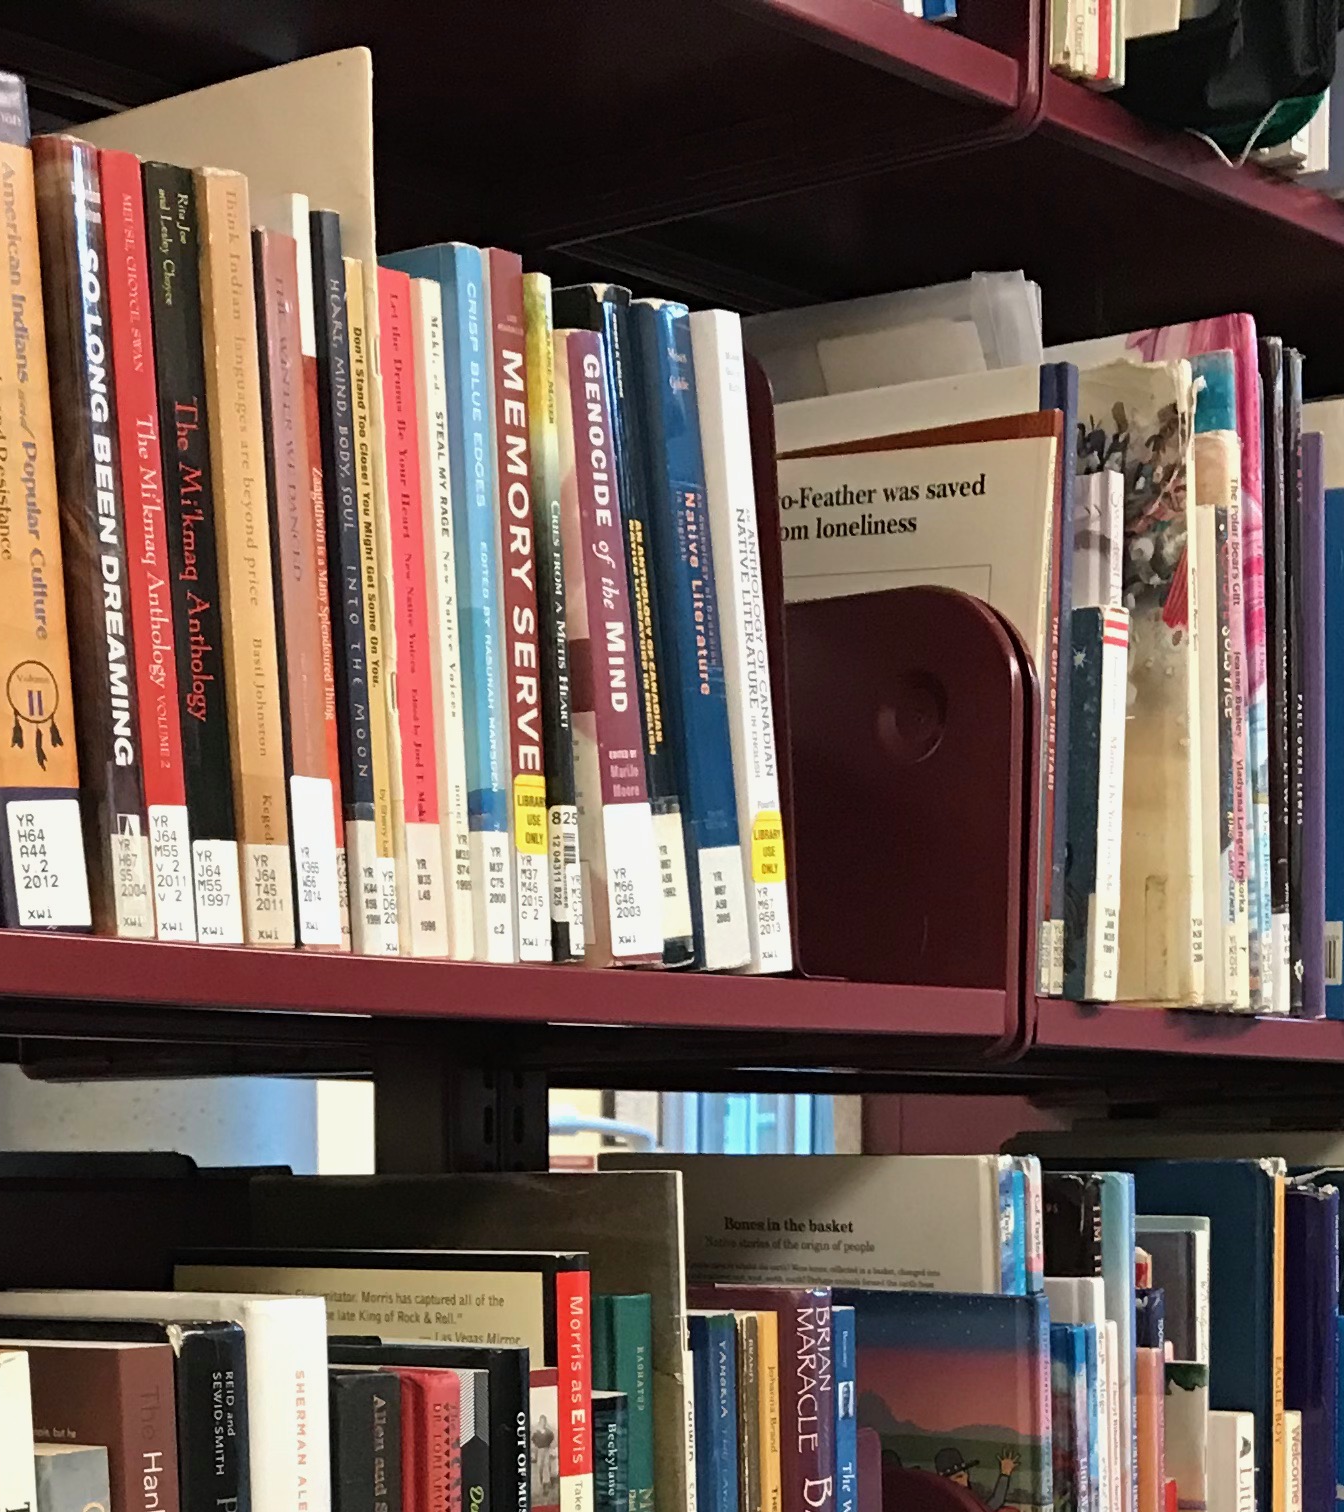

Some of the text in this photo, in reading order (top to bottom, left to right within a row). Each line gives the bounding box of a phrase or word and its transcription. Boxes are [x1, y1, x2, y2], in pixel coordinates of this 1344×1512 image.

[84, 249, 133, 766] SO LONG BEEN DREAMING
[501, 348, 540, 771] MEMORY SERVE
[582, 353, 628, 713] GENOCIDE of the MIND
[777, 473, 986, 510] o-Feather was saved
[815, 515, 917, 539] loneliness
[768, 1218, 780, 1231] in
[784, 1218, 805, 1232] the
[809, 1219, 853, 1233] basket
[570, 1296, 586, 1465] Morris as Elvis
[796, 1307, 818, 1454] MARACLE
[816, 1307, 831, 1391] BRIAN
